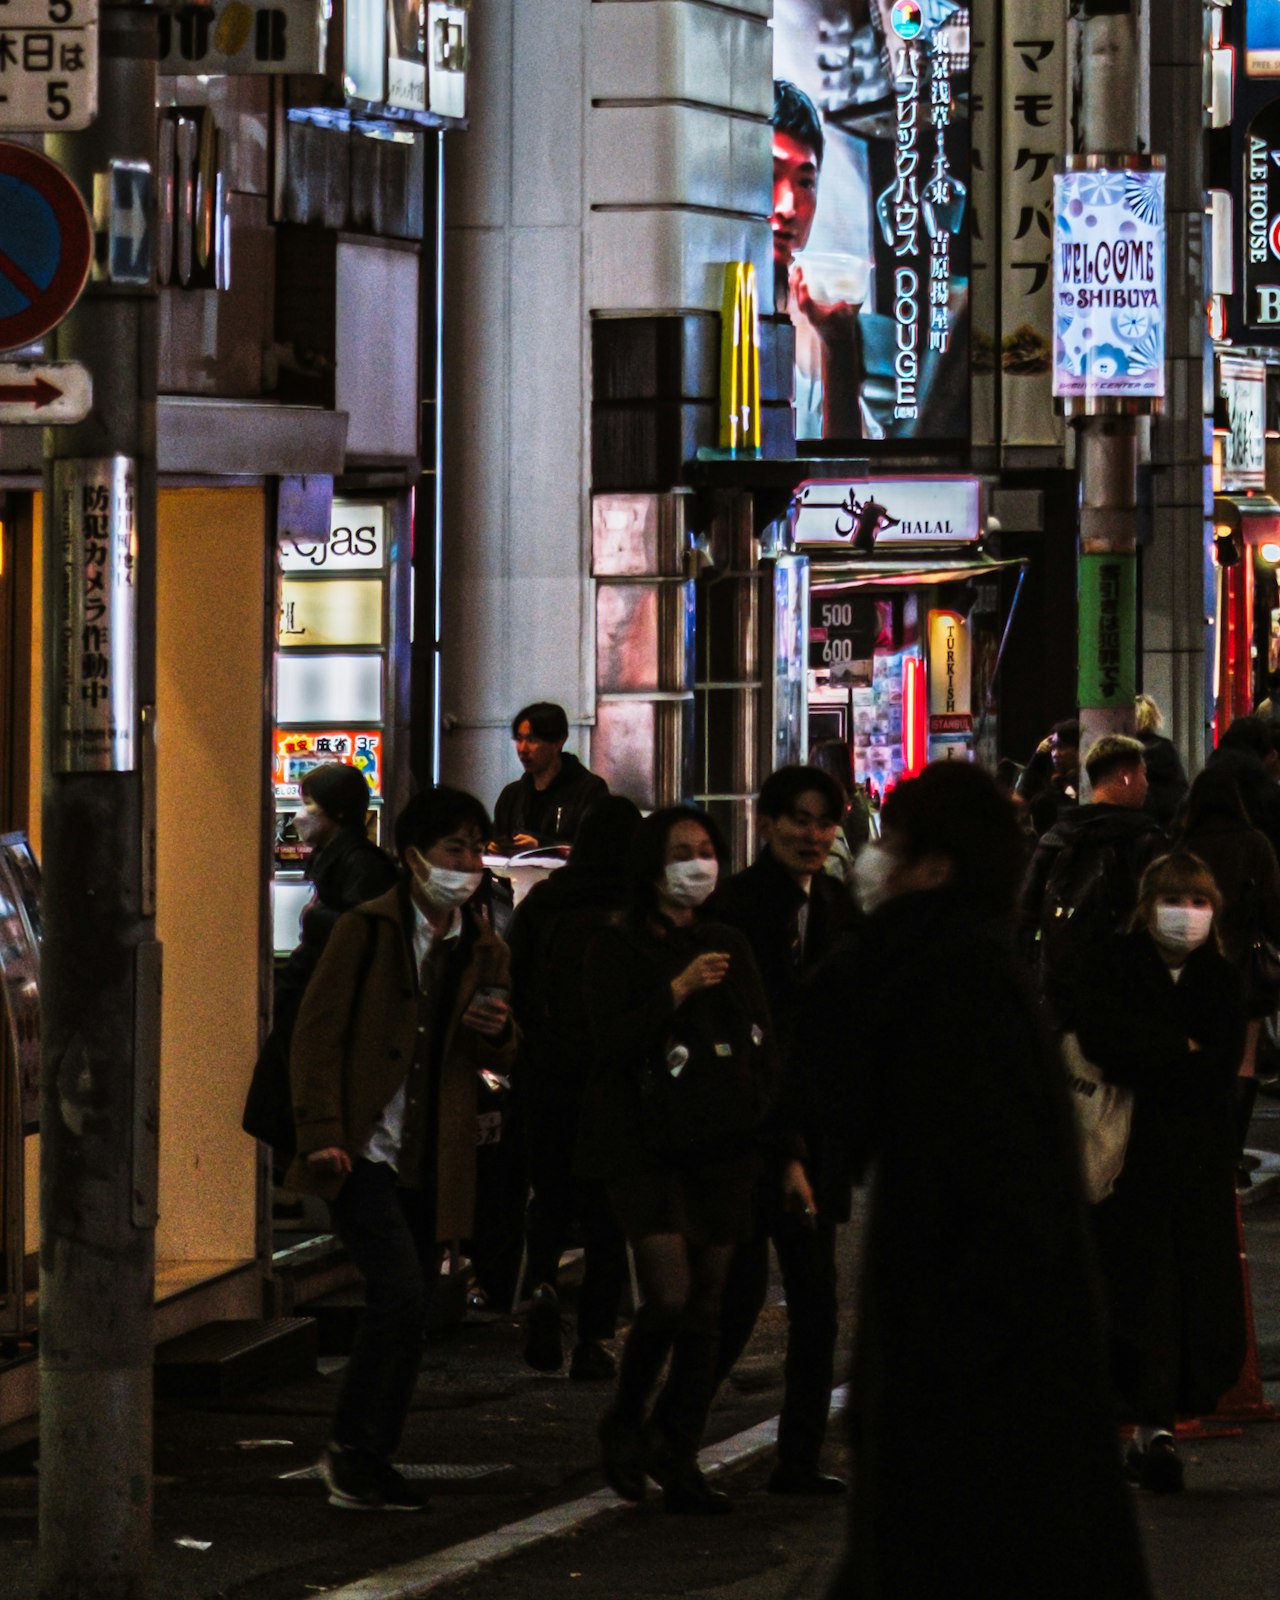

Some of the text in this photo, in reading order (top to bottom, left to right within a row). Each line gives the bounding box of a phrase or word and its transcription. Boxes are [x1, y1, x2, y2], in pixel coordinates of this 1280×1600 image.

[1252, 60, 1272, 70] FREE
[46, 82, 73, 122] 5
[893, 49, 920, 258] パブリックハウス
[1250, 135, 1269, 264] ALE HOUSE
[1060, 239, 1155, 286] WELCOME
[1076, 288, 1160, 310] SHIBUYA
[901, 520, 954, 534] HALAL
[81, 485, 110, 710] 防犯カメラ作動中
[822, 603, 852, 628] 500
[822, 638, 852, 662] 600
[946, 626, 955, 713] TURKISH
[355, 736, 378, 751] 3F
